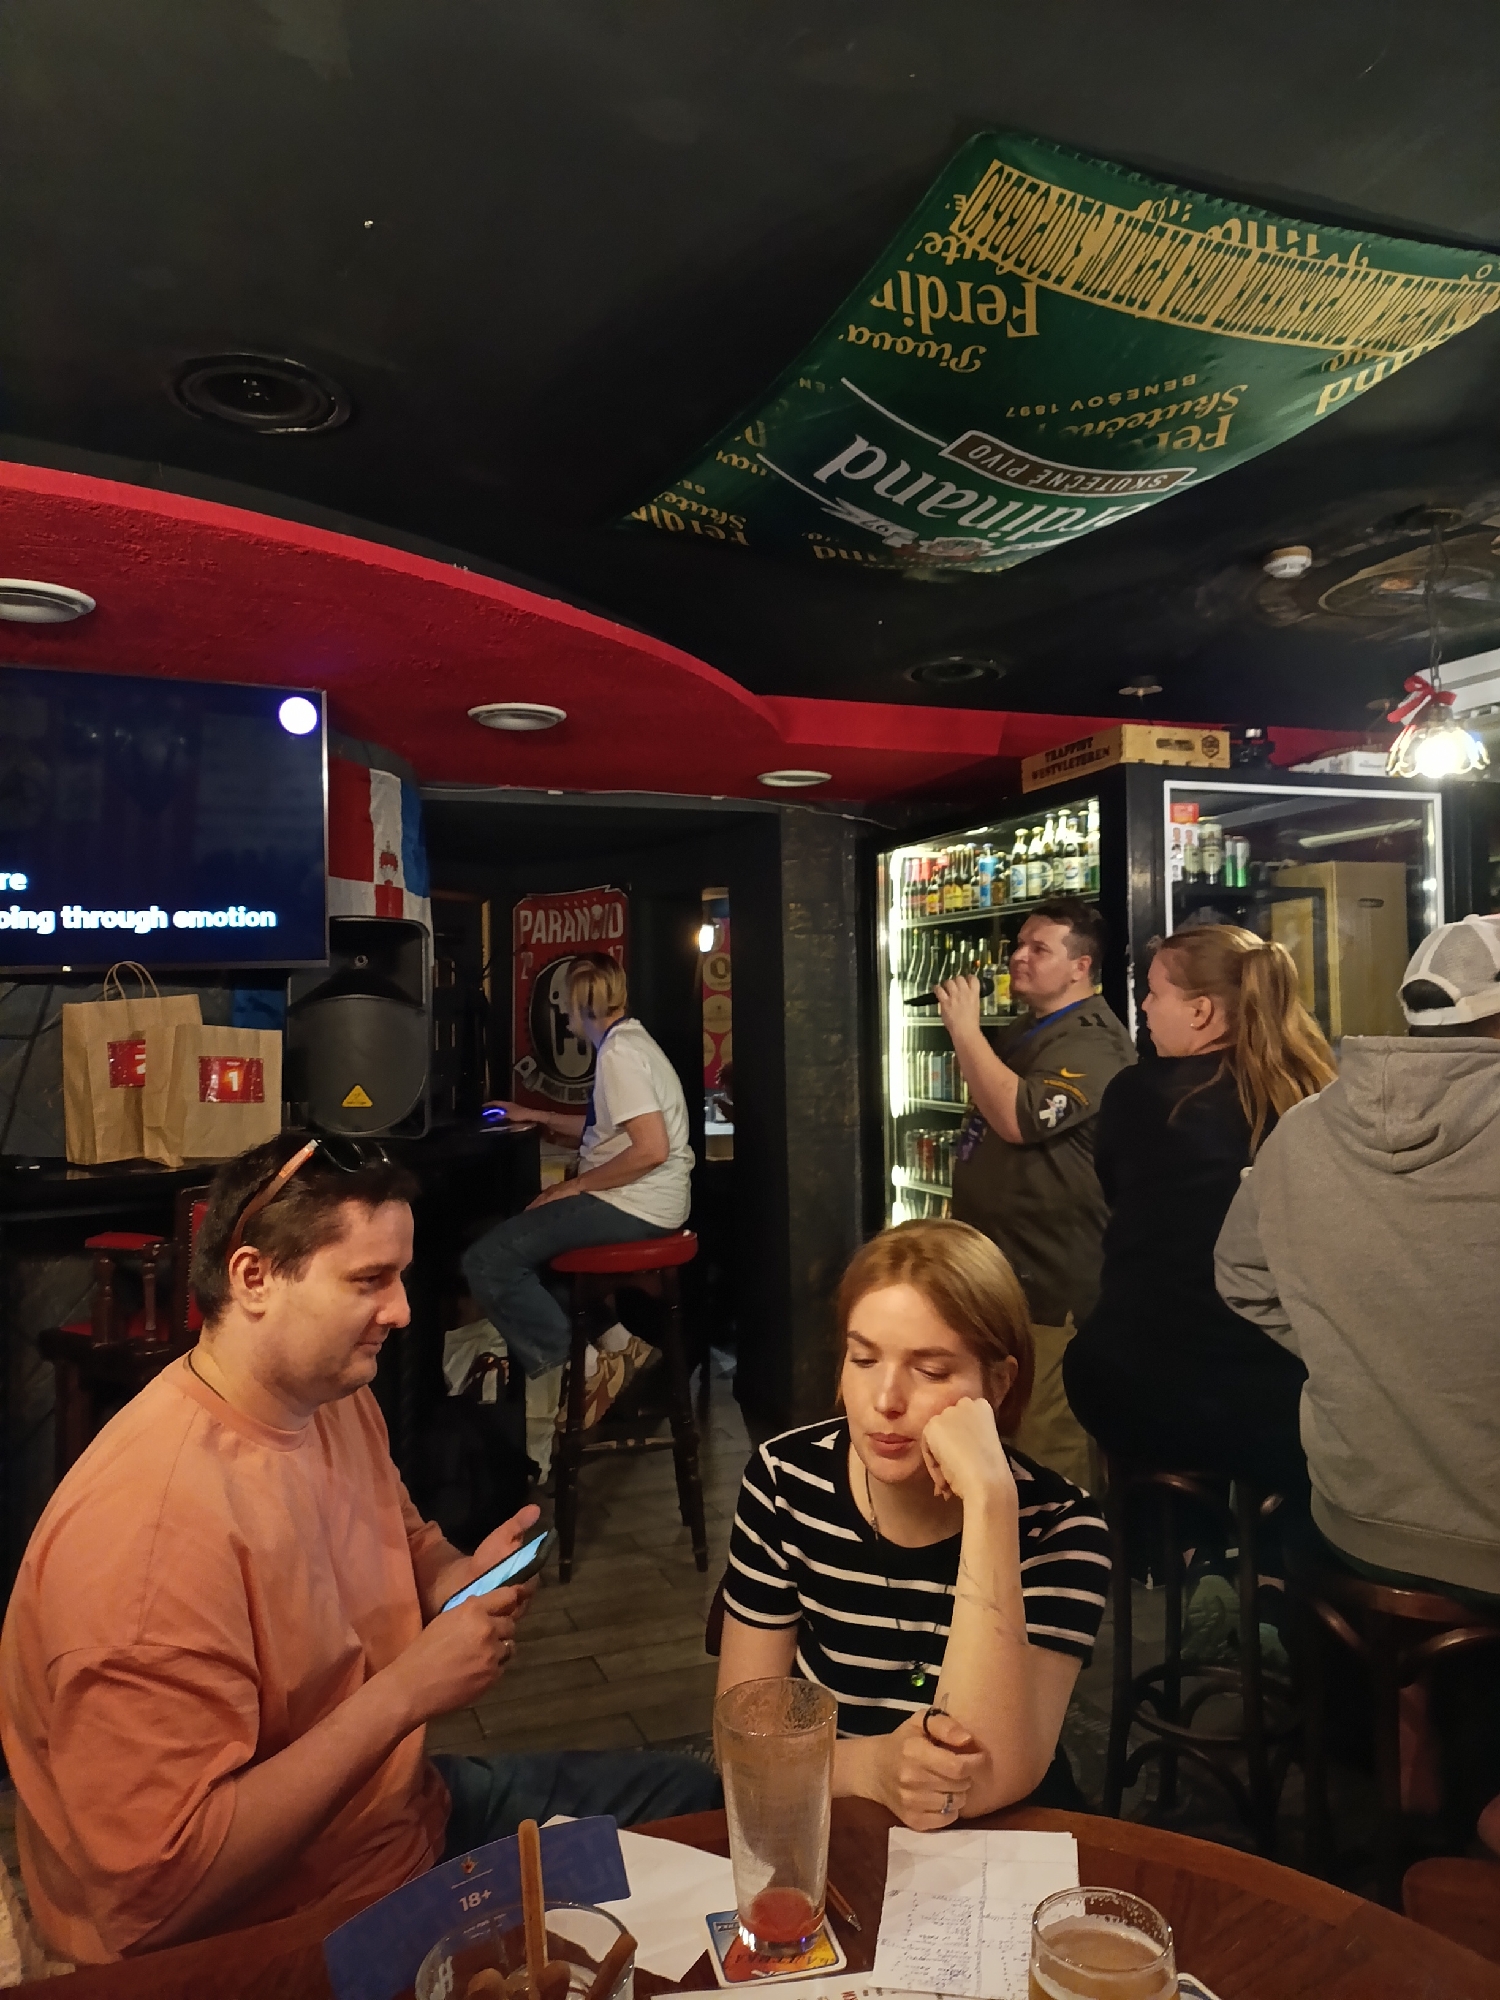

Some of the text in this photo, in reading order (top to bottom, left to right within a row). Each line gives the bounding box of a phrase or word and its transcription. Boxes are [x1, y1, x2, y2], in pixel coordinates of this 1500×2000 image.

[838, 324, 987, 373] Pivova
[1004, 401, 1060, 419] 1897
[968, 444, 1031, 479] PIVO
[60, 905, 169, 934] through
[172, 905, 278, 929] emotion
[459, 1889, 492, 1912] 18+
